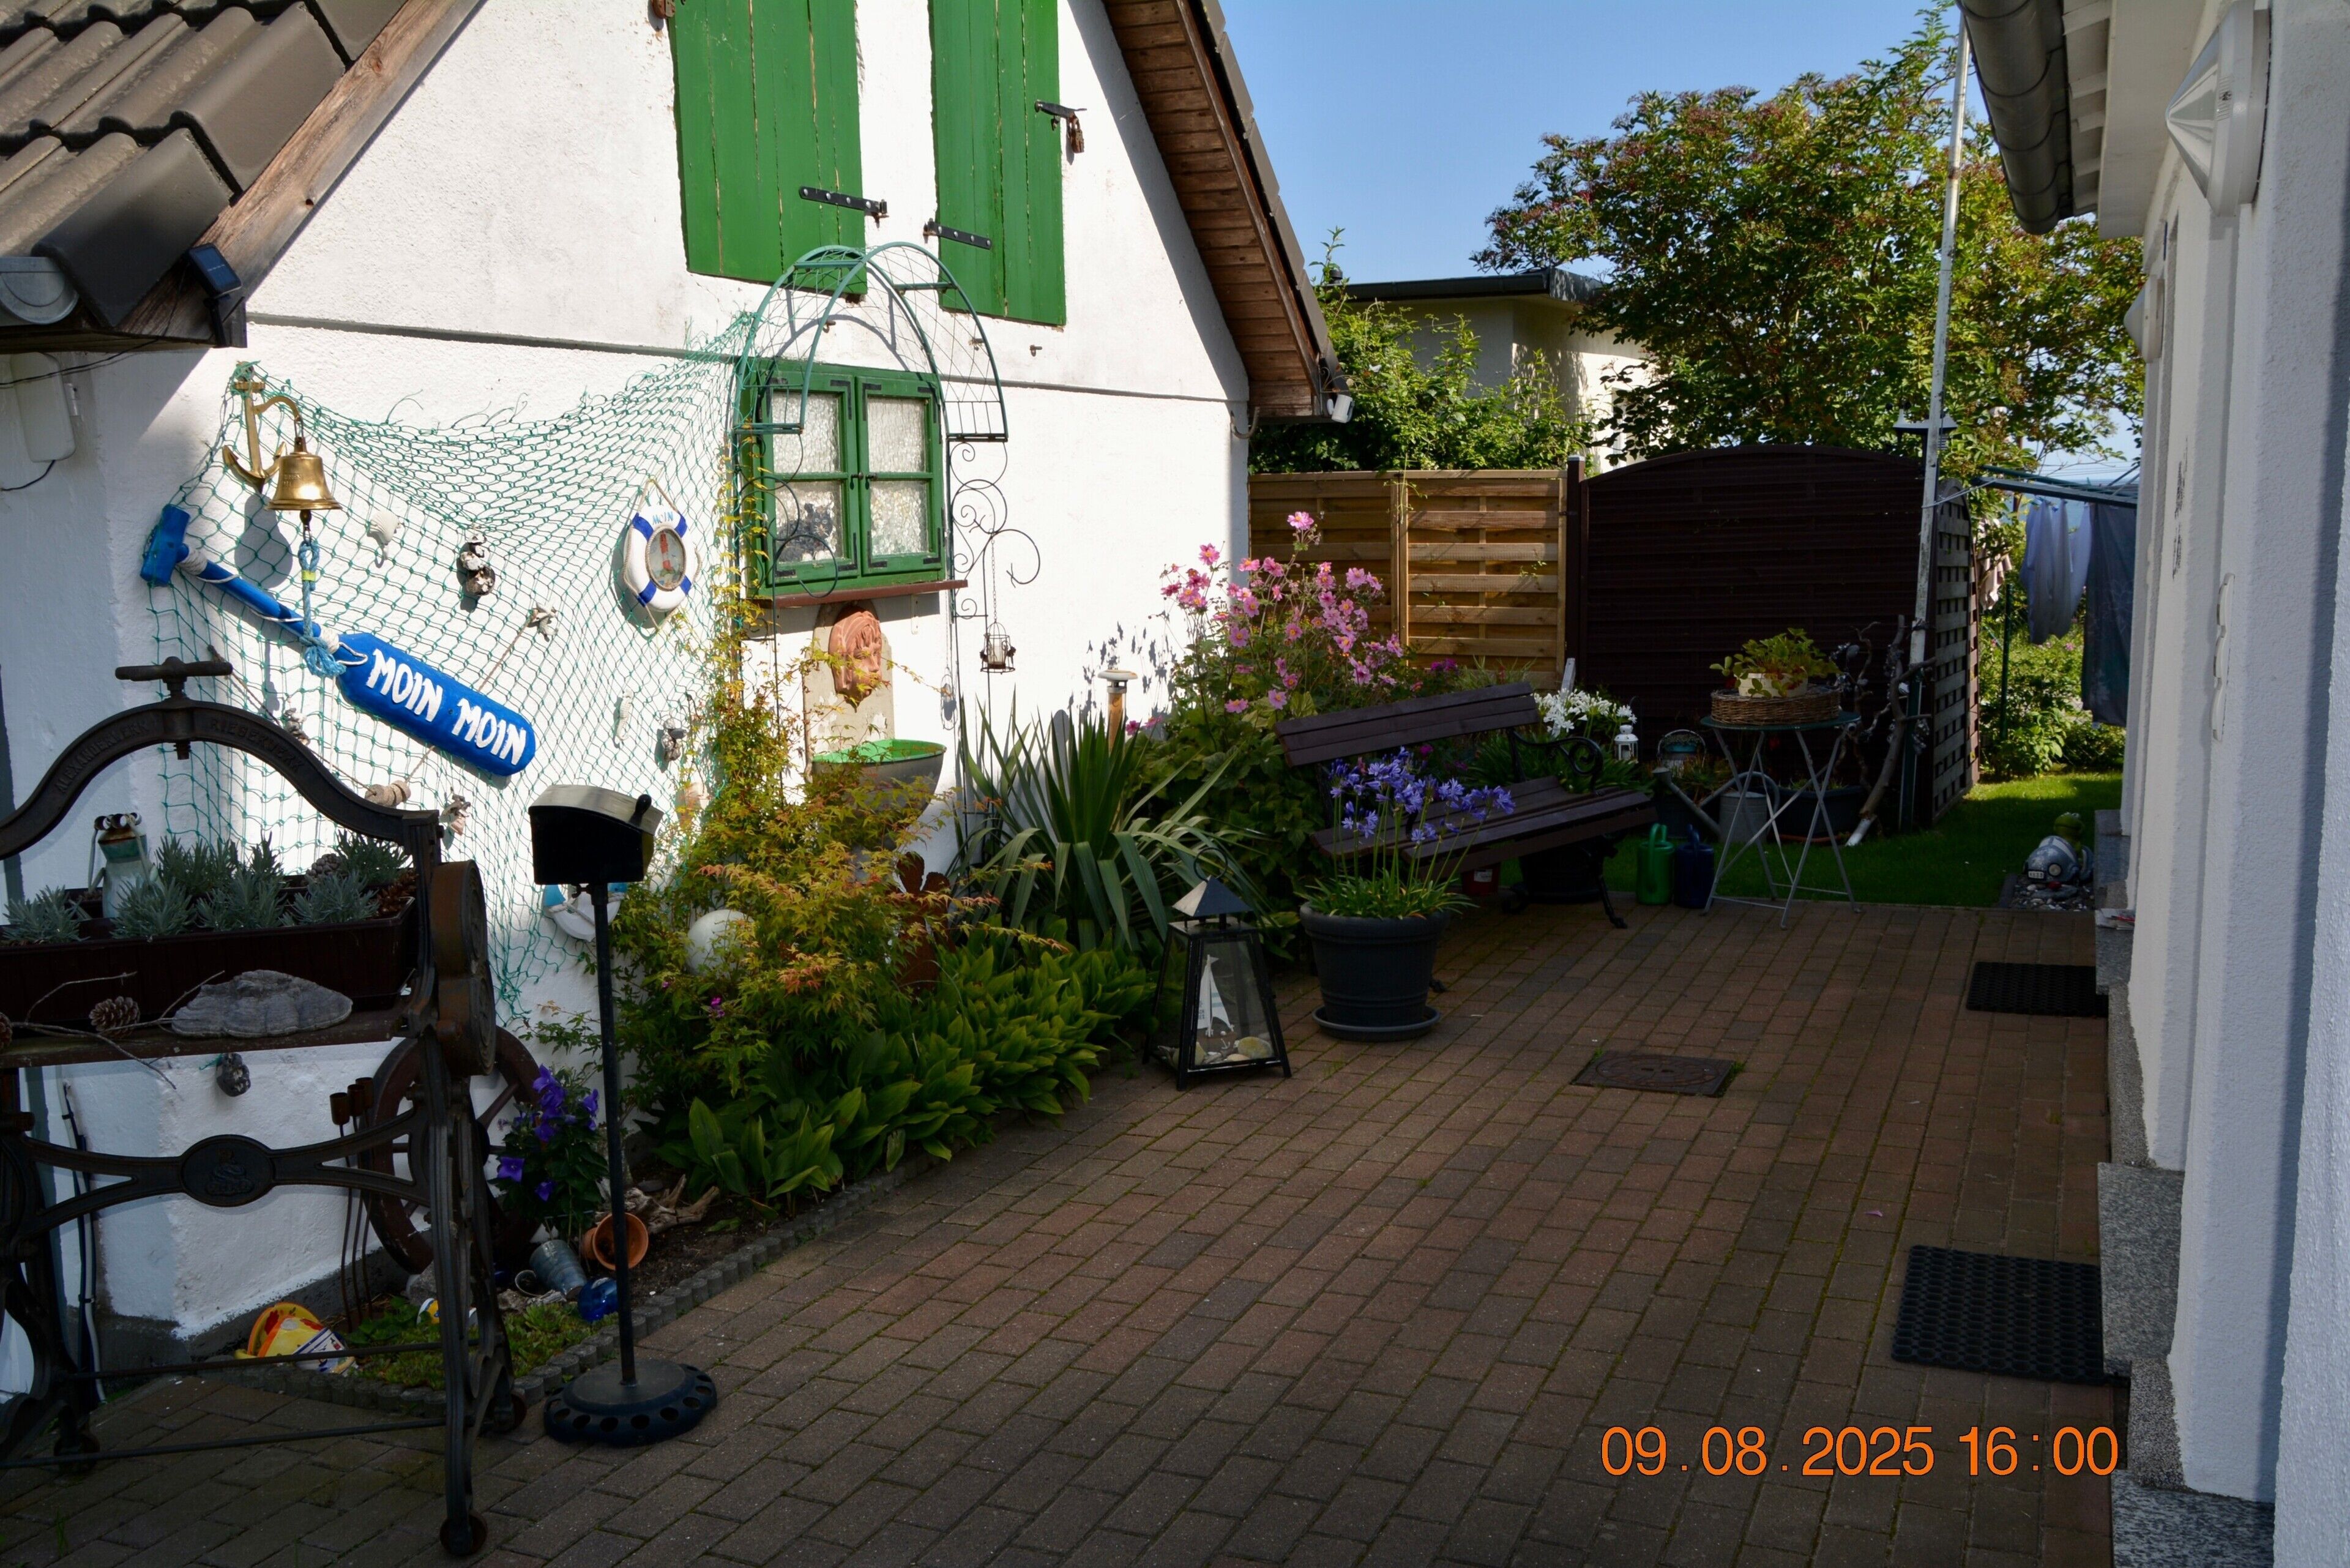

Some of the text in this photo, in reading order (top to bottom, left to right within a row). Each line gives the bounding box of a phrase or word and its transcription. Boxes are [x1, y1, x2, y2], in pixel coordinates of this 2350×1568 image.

[652, 512, 674, 525] MOIN
[366, 648, 526, 765] MOIN MOIN
